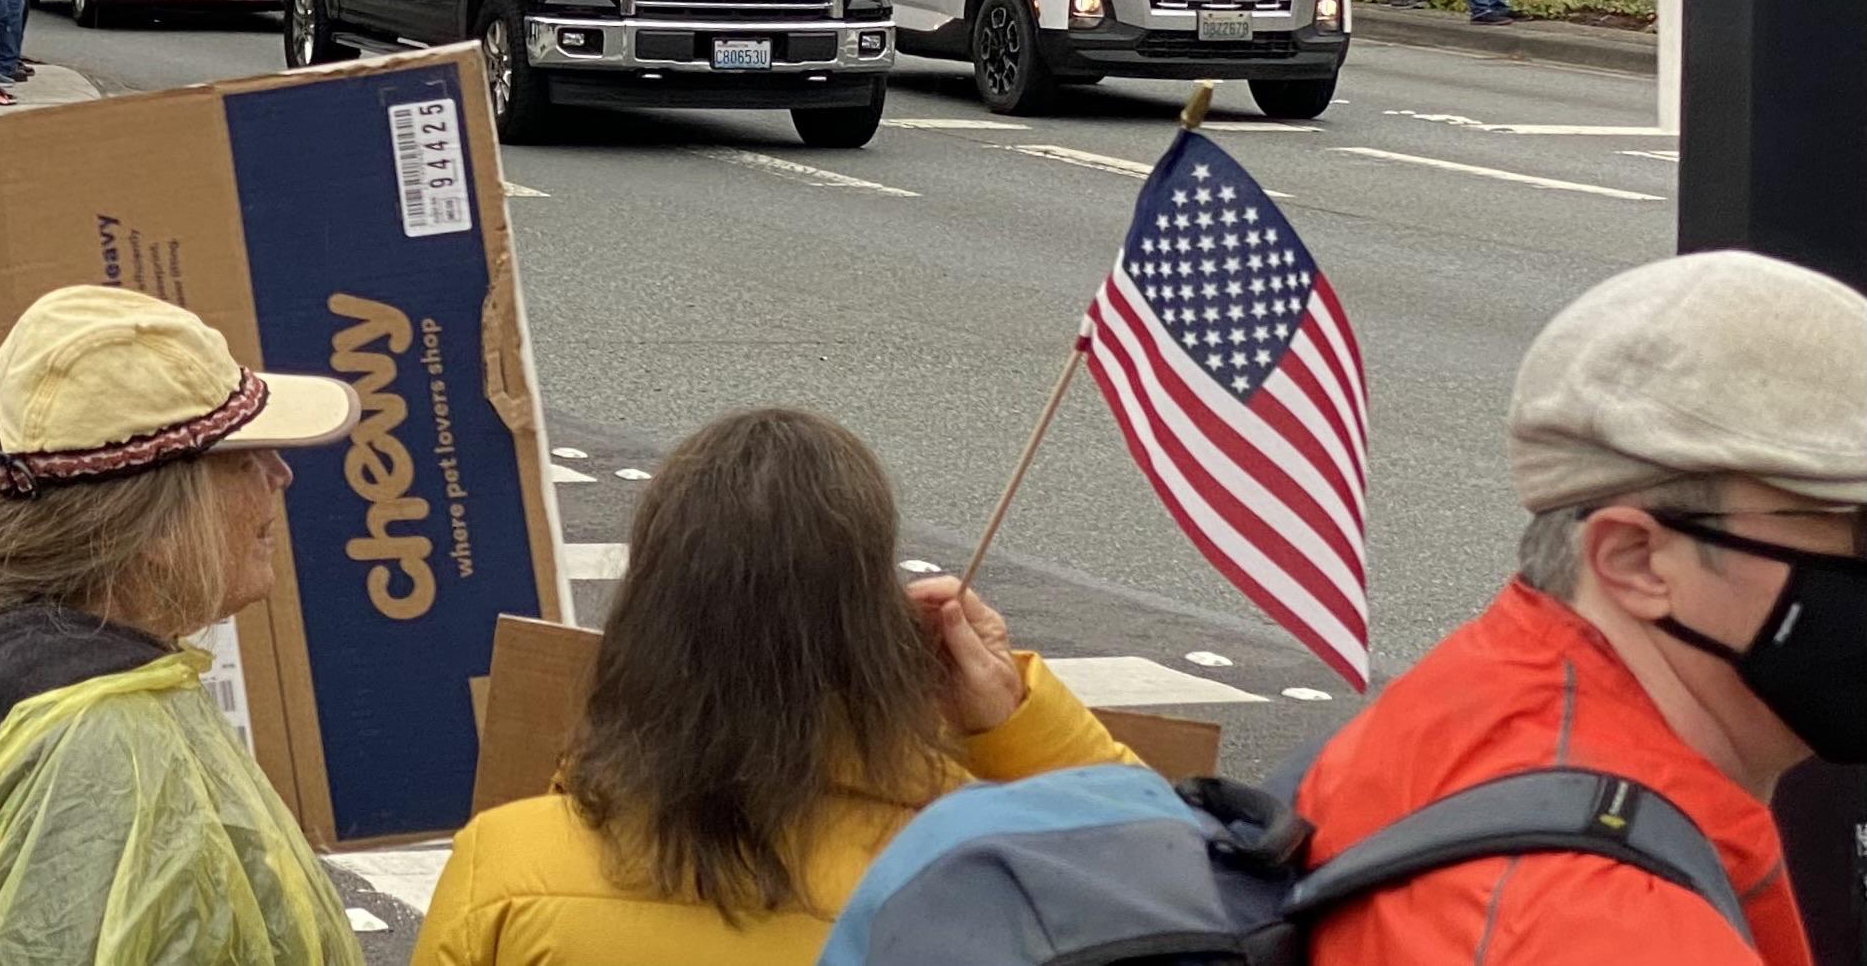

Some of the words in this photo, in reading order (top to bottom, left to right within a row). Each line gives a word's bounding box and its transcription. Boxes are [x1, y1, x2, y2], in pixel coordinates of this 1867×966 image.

[715, 49, 768, 65] C80653U
[419, 316, 445, 377] shop
[429, 378, 459, 455] lovers
[326, 292, 437, 620] chewy
[438, 454, 469, 500] pet
[449, 502, 475, 579] where
